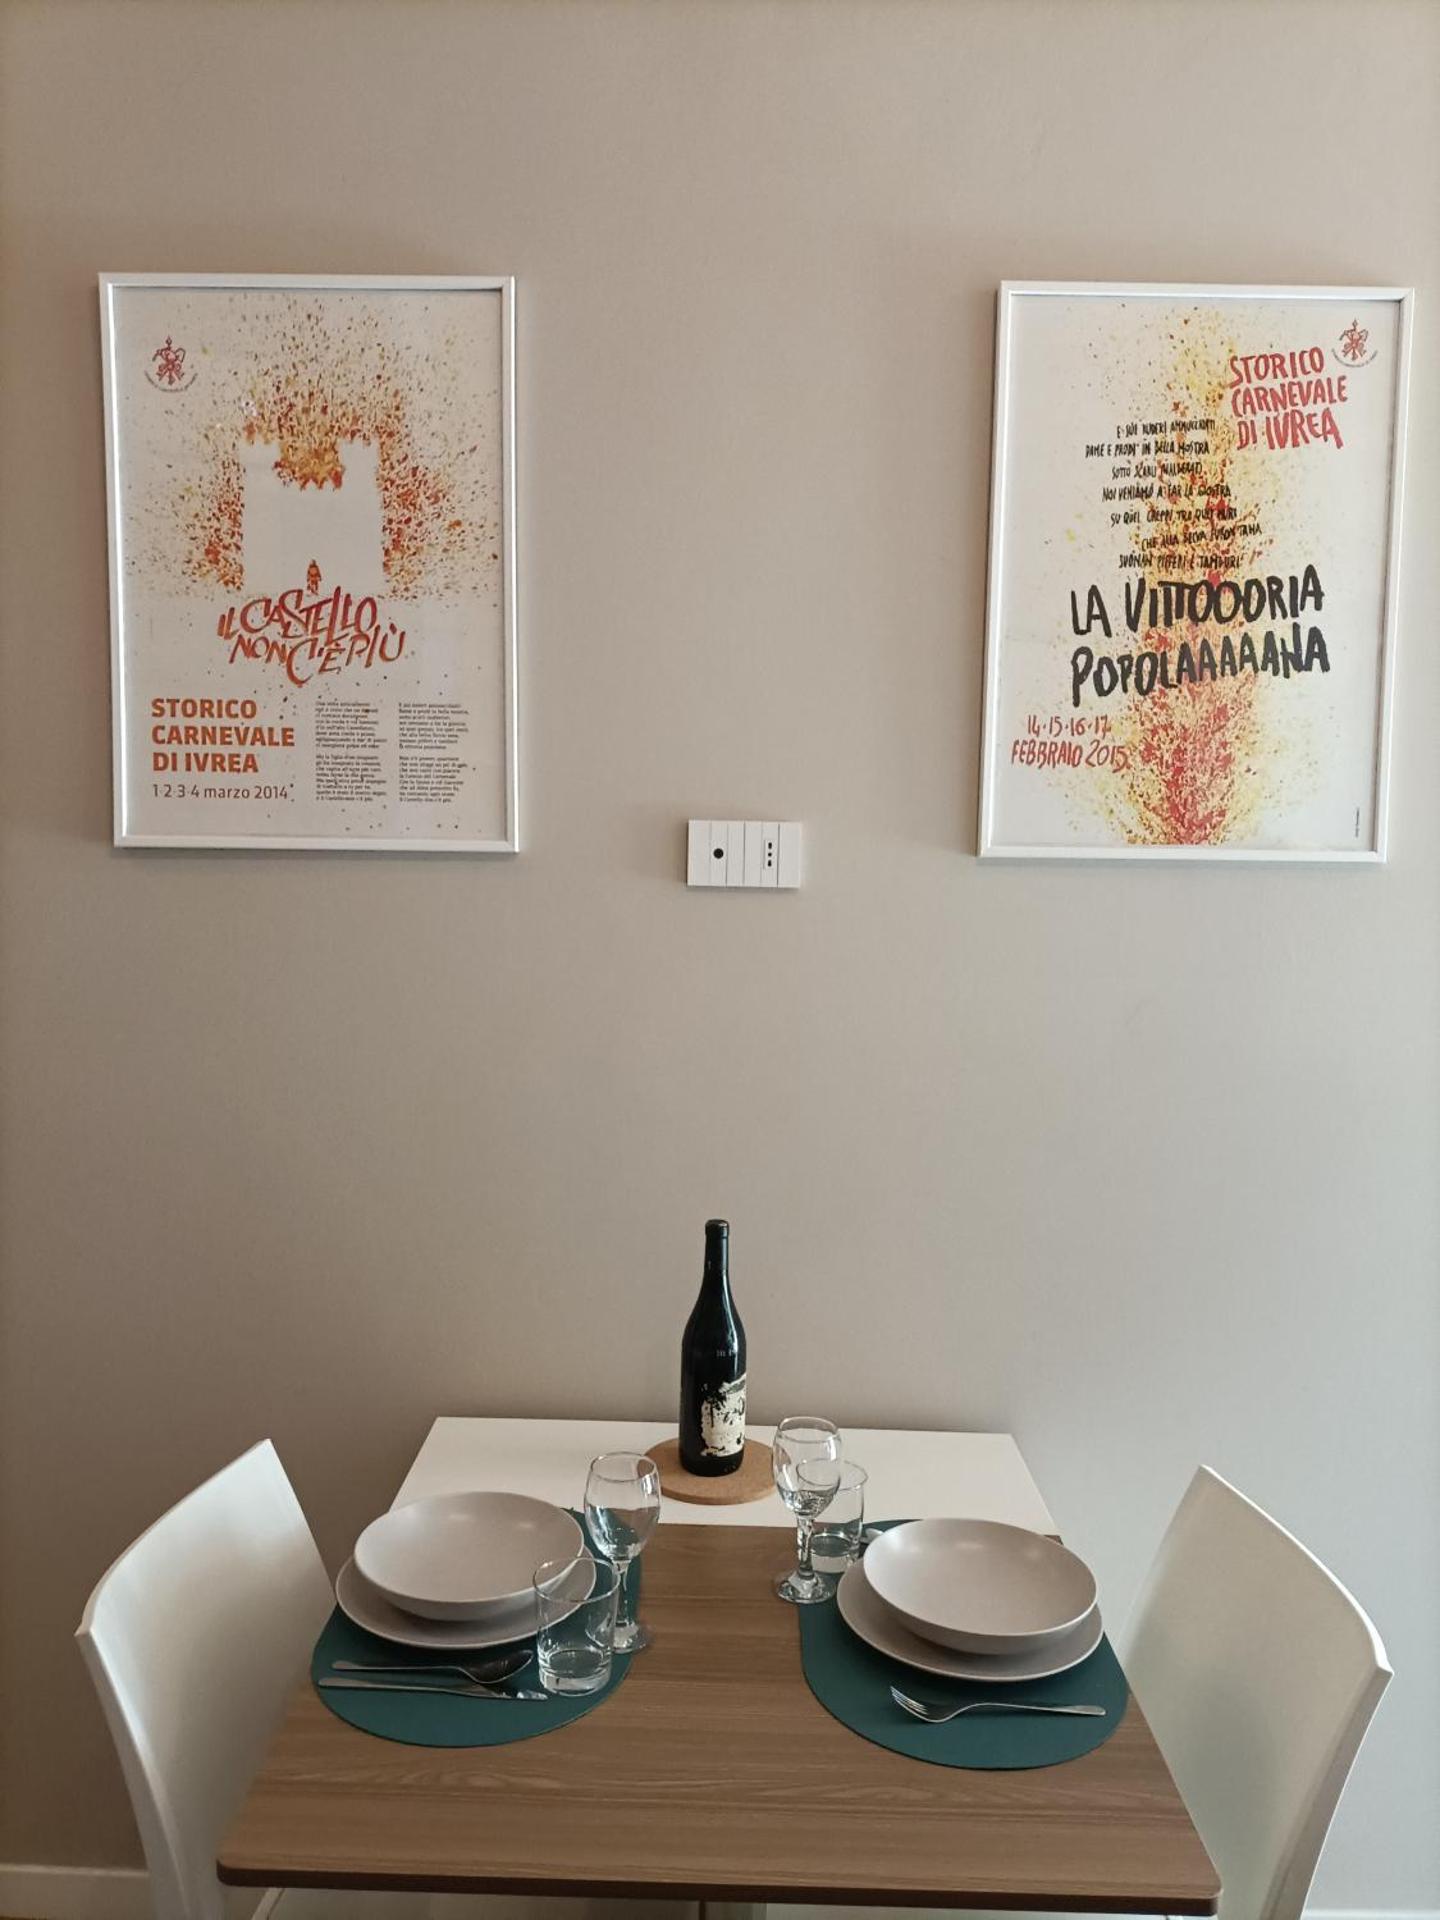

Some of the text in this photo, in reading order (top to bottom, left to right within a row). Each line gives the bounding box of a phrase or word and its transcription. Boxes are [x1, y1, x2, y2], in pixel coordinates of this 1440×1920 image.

[1226, 346, 1324, 389] STORICO
[1231, 375, 1348, 418] CARNEVALE
[1237, 407, 1343, 450] DI IVREA
[1085, 443, 1105, 458] DAME
[1107, 444, 1112, 457] E
[1141, 442, 1151, 456] IN
[1178, 440, 1210, 454] MOSTRA
[1112, 465, 1131, 480] SOTTO
[1102, 486, 1117, 501] NOI
[1156, 487, 1163, 498] A
[1184, 486, 1193, 498] LA
[1111, 512, 1121, 527] SU
[1142, 536, 1158, 551] CHE
[1071, 564, 1325, 638] LA VITTOOORIA
[217, 586, 378, 647] IL CASTELLO
[229, 633, 288, 665] NON
[346, 621, 406, 669] PIÙ
[1071, 621, 1331, 708] POPOLAAAAANA
[151, 697, 257, 719] STORICO
[151, 724, 296, 747] CARNEVALE
[152, 751, 259, 773] DI IVREA
[1011, 739, 1129, 773] FEBBRAIO 2015
[203, 786, 250, 799] marzo
[254, 785, 288, 799] 2014
